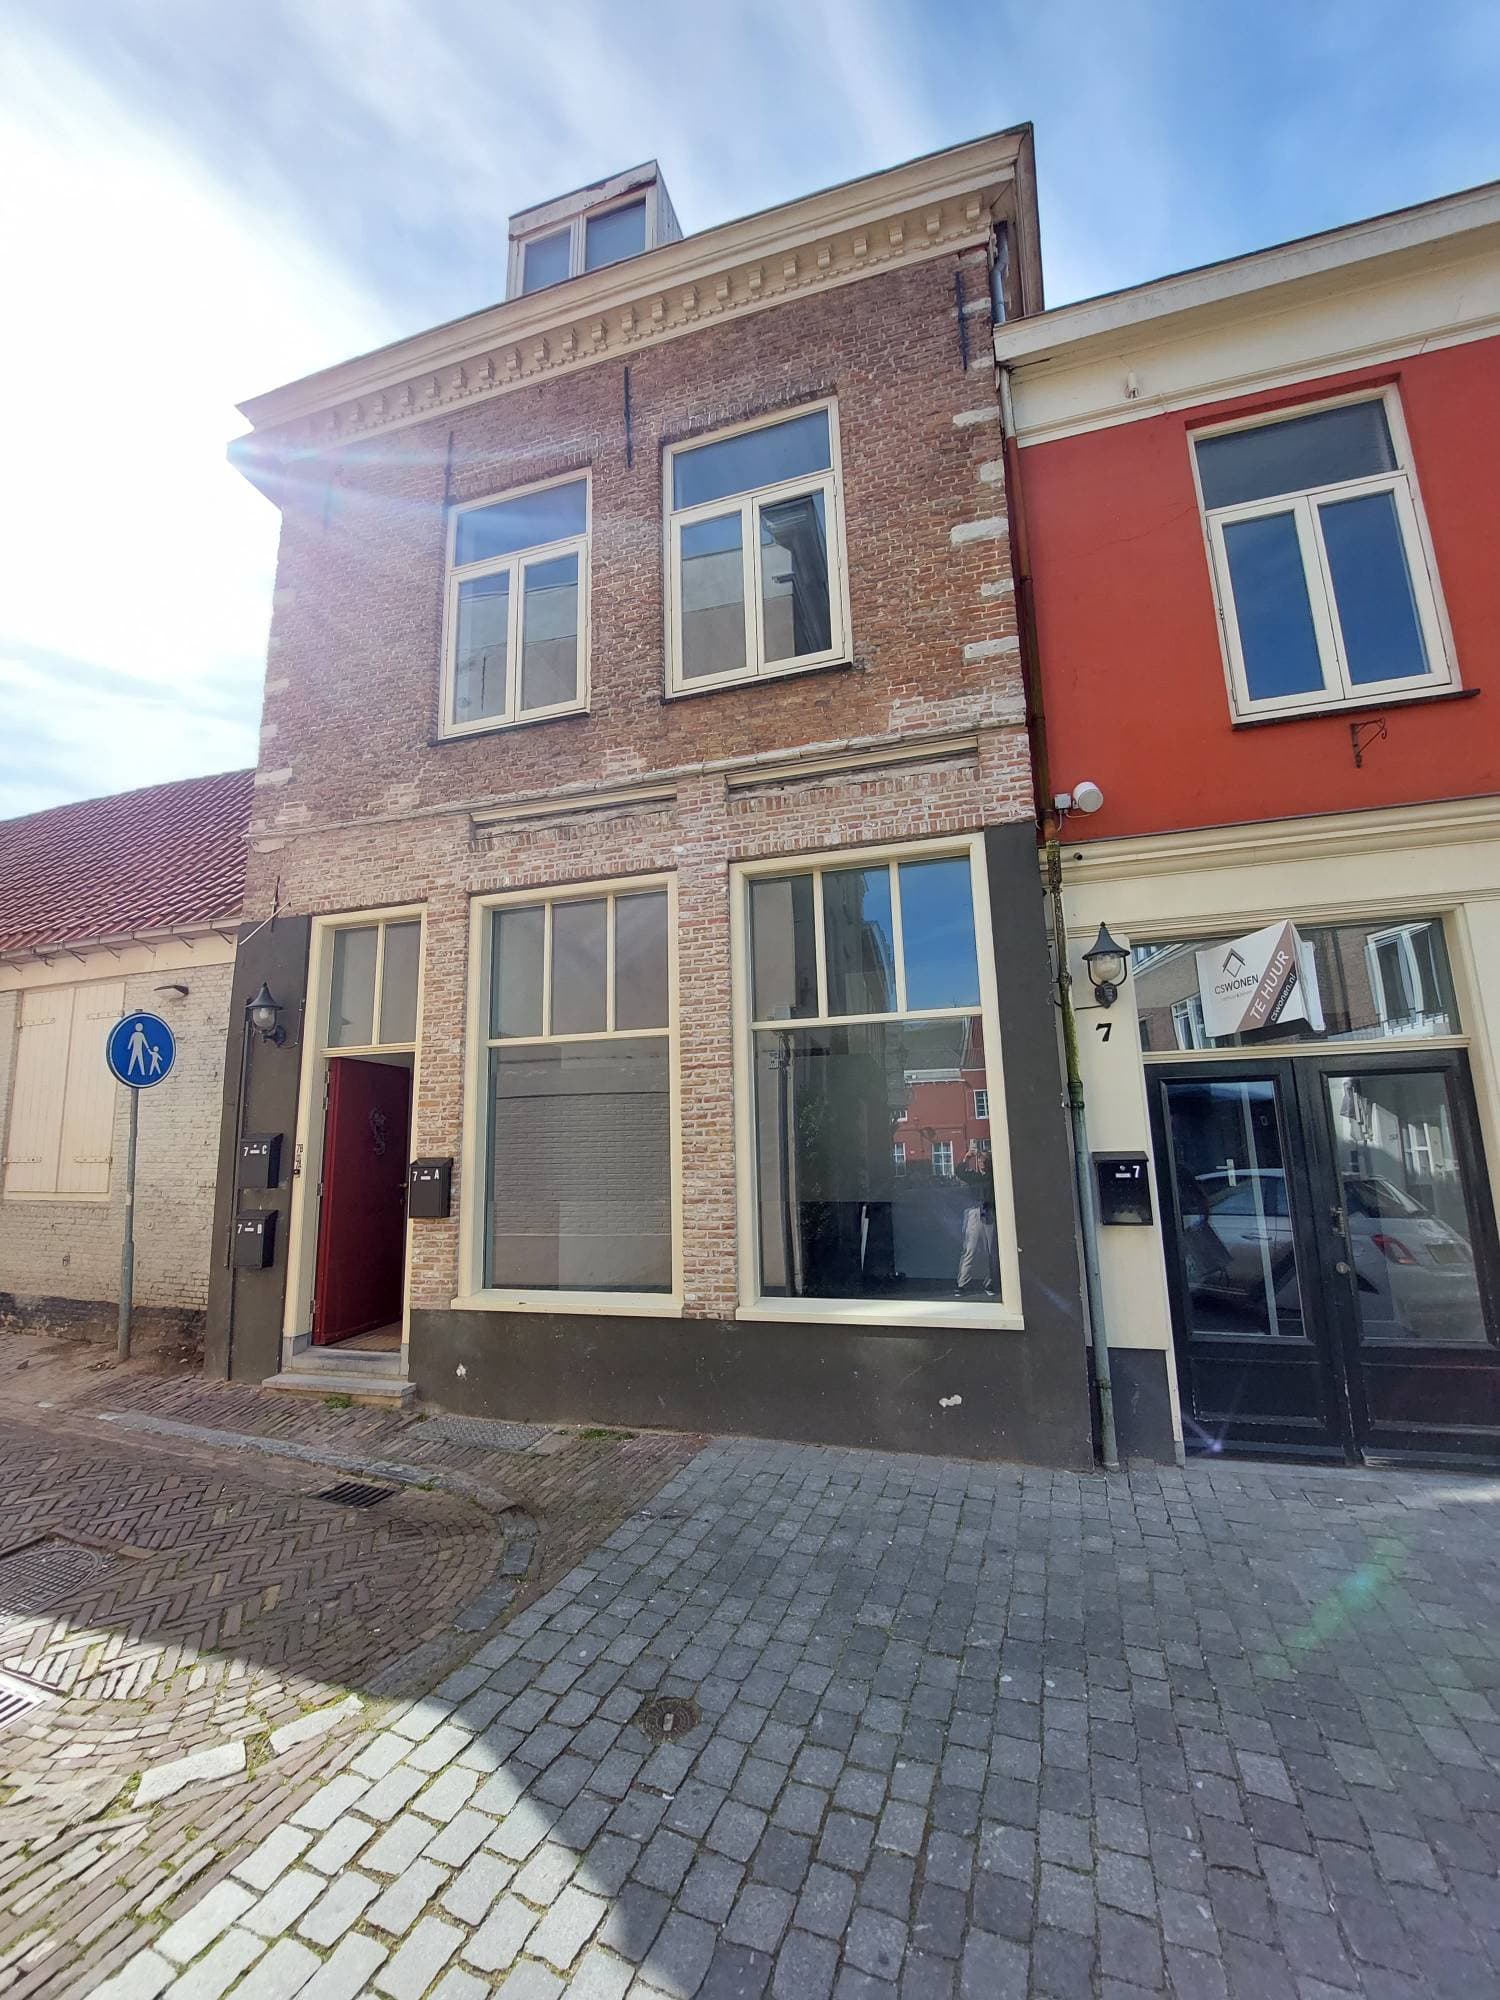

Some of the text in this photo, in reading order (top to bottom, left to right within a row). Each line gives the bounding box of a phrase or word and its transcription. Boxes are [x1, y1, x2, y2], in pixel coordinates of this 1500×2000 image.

[1214, 974, 1259, 994] CSWONEN
[1250, 950, 1289, 1020] TE HUUR
[1270, 974, 1296, 1022] cswonen.nl
[1095, 1022, 1113, 1042] 7
[243, 1144, 268, 1157] 7 C
[412, 1168, 440, 1182] 7 A
[1132, 1165, 1140, 1178] 7
[237, 1224, 242, 1234] 7
